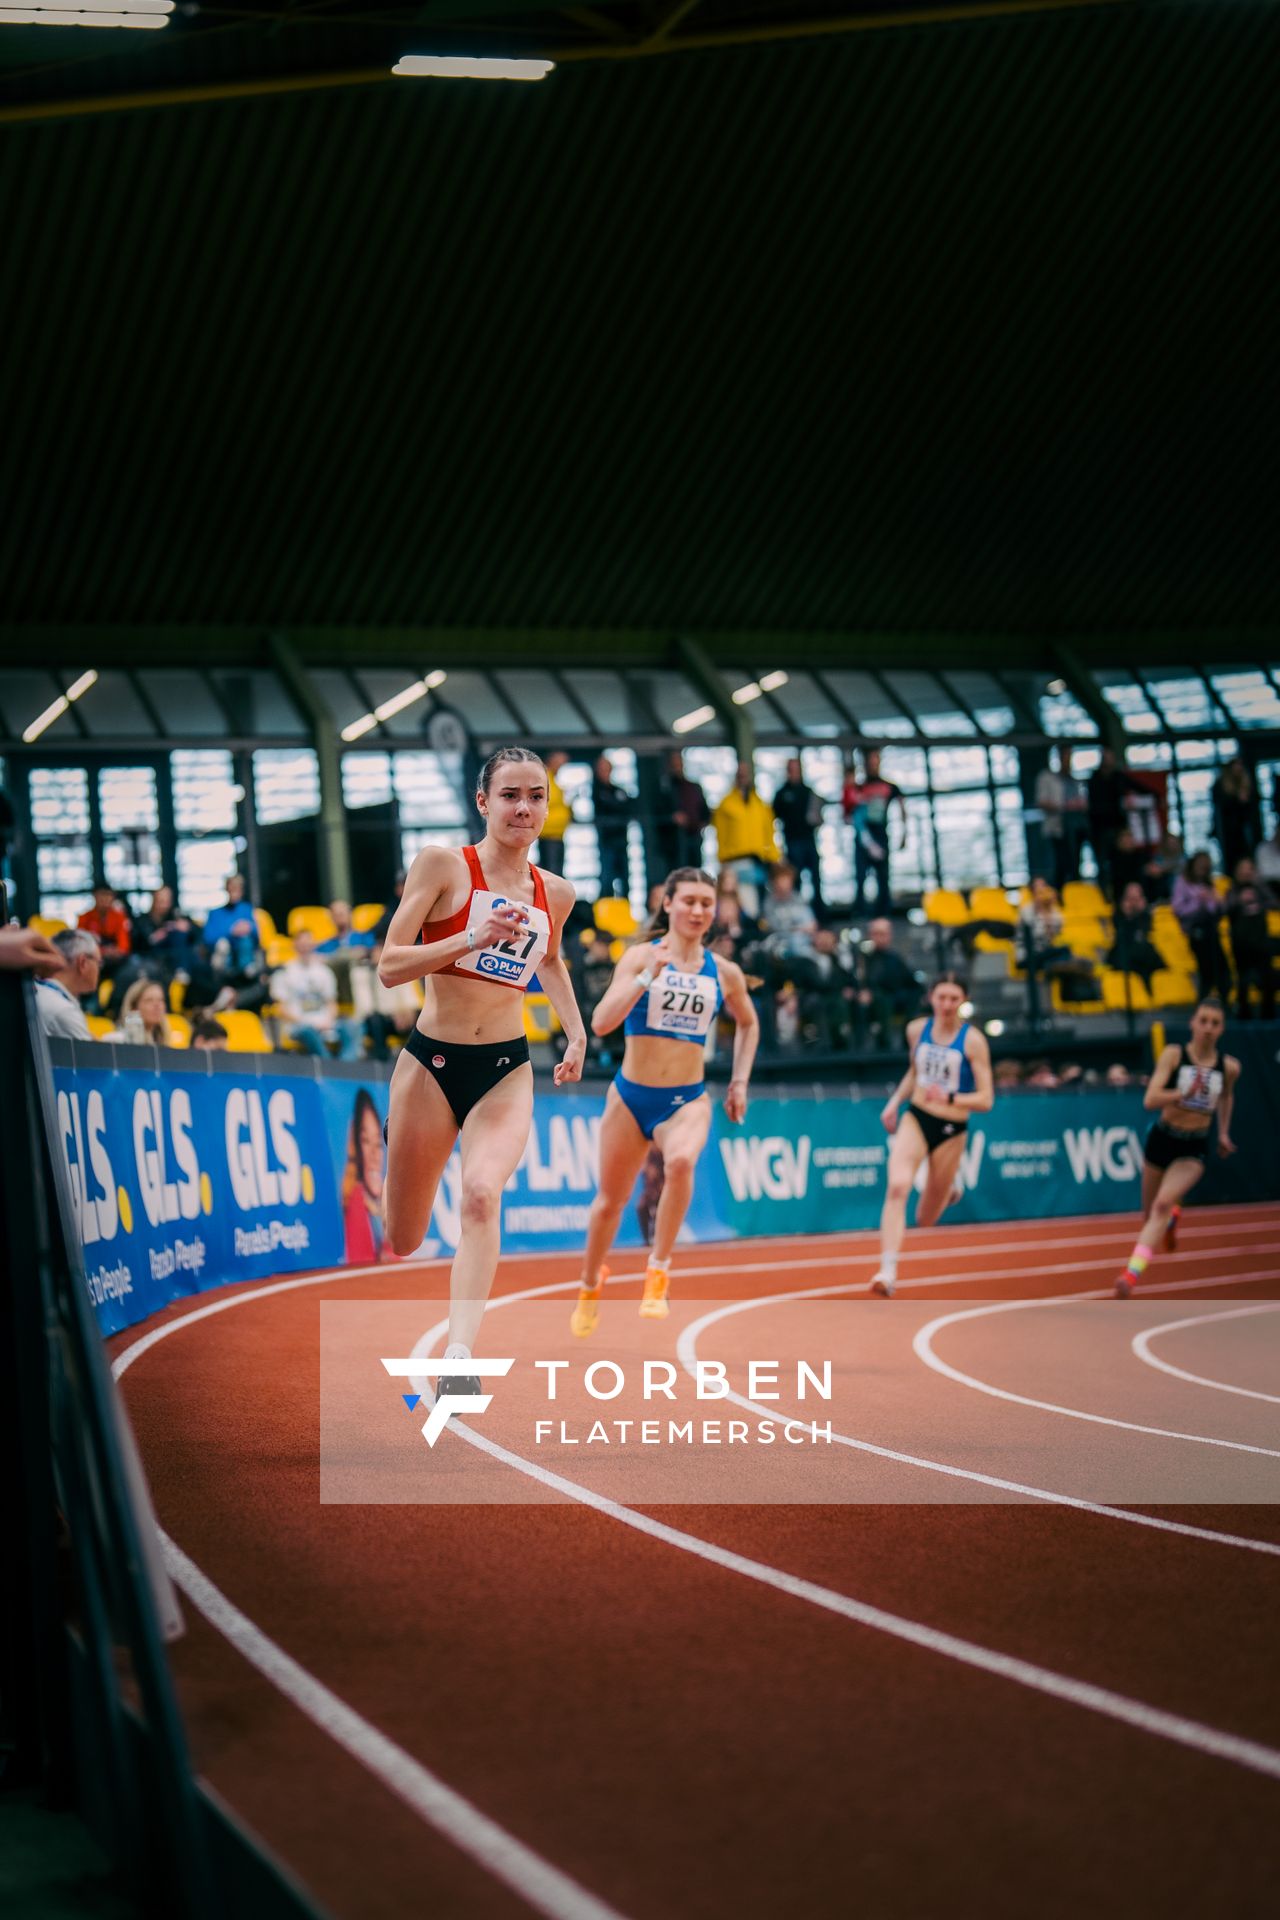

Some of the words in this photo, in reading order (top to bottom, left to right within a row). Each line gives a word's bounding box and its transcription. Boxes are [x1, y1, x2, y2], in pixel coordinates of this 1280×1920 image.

[491, 929, 538, 959] 27
[499, 960, 524, 975] PLAN
[666, 975, 697, 989] GLS
[662, 990, 704, 1014] 276
[719, 1135, 811, 1202] WGV
